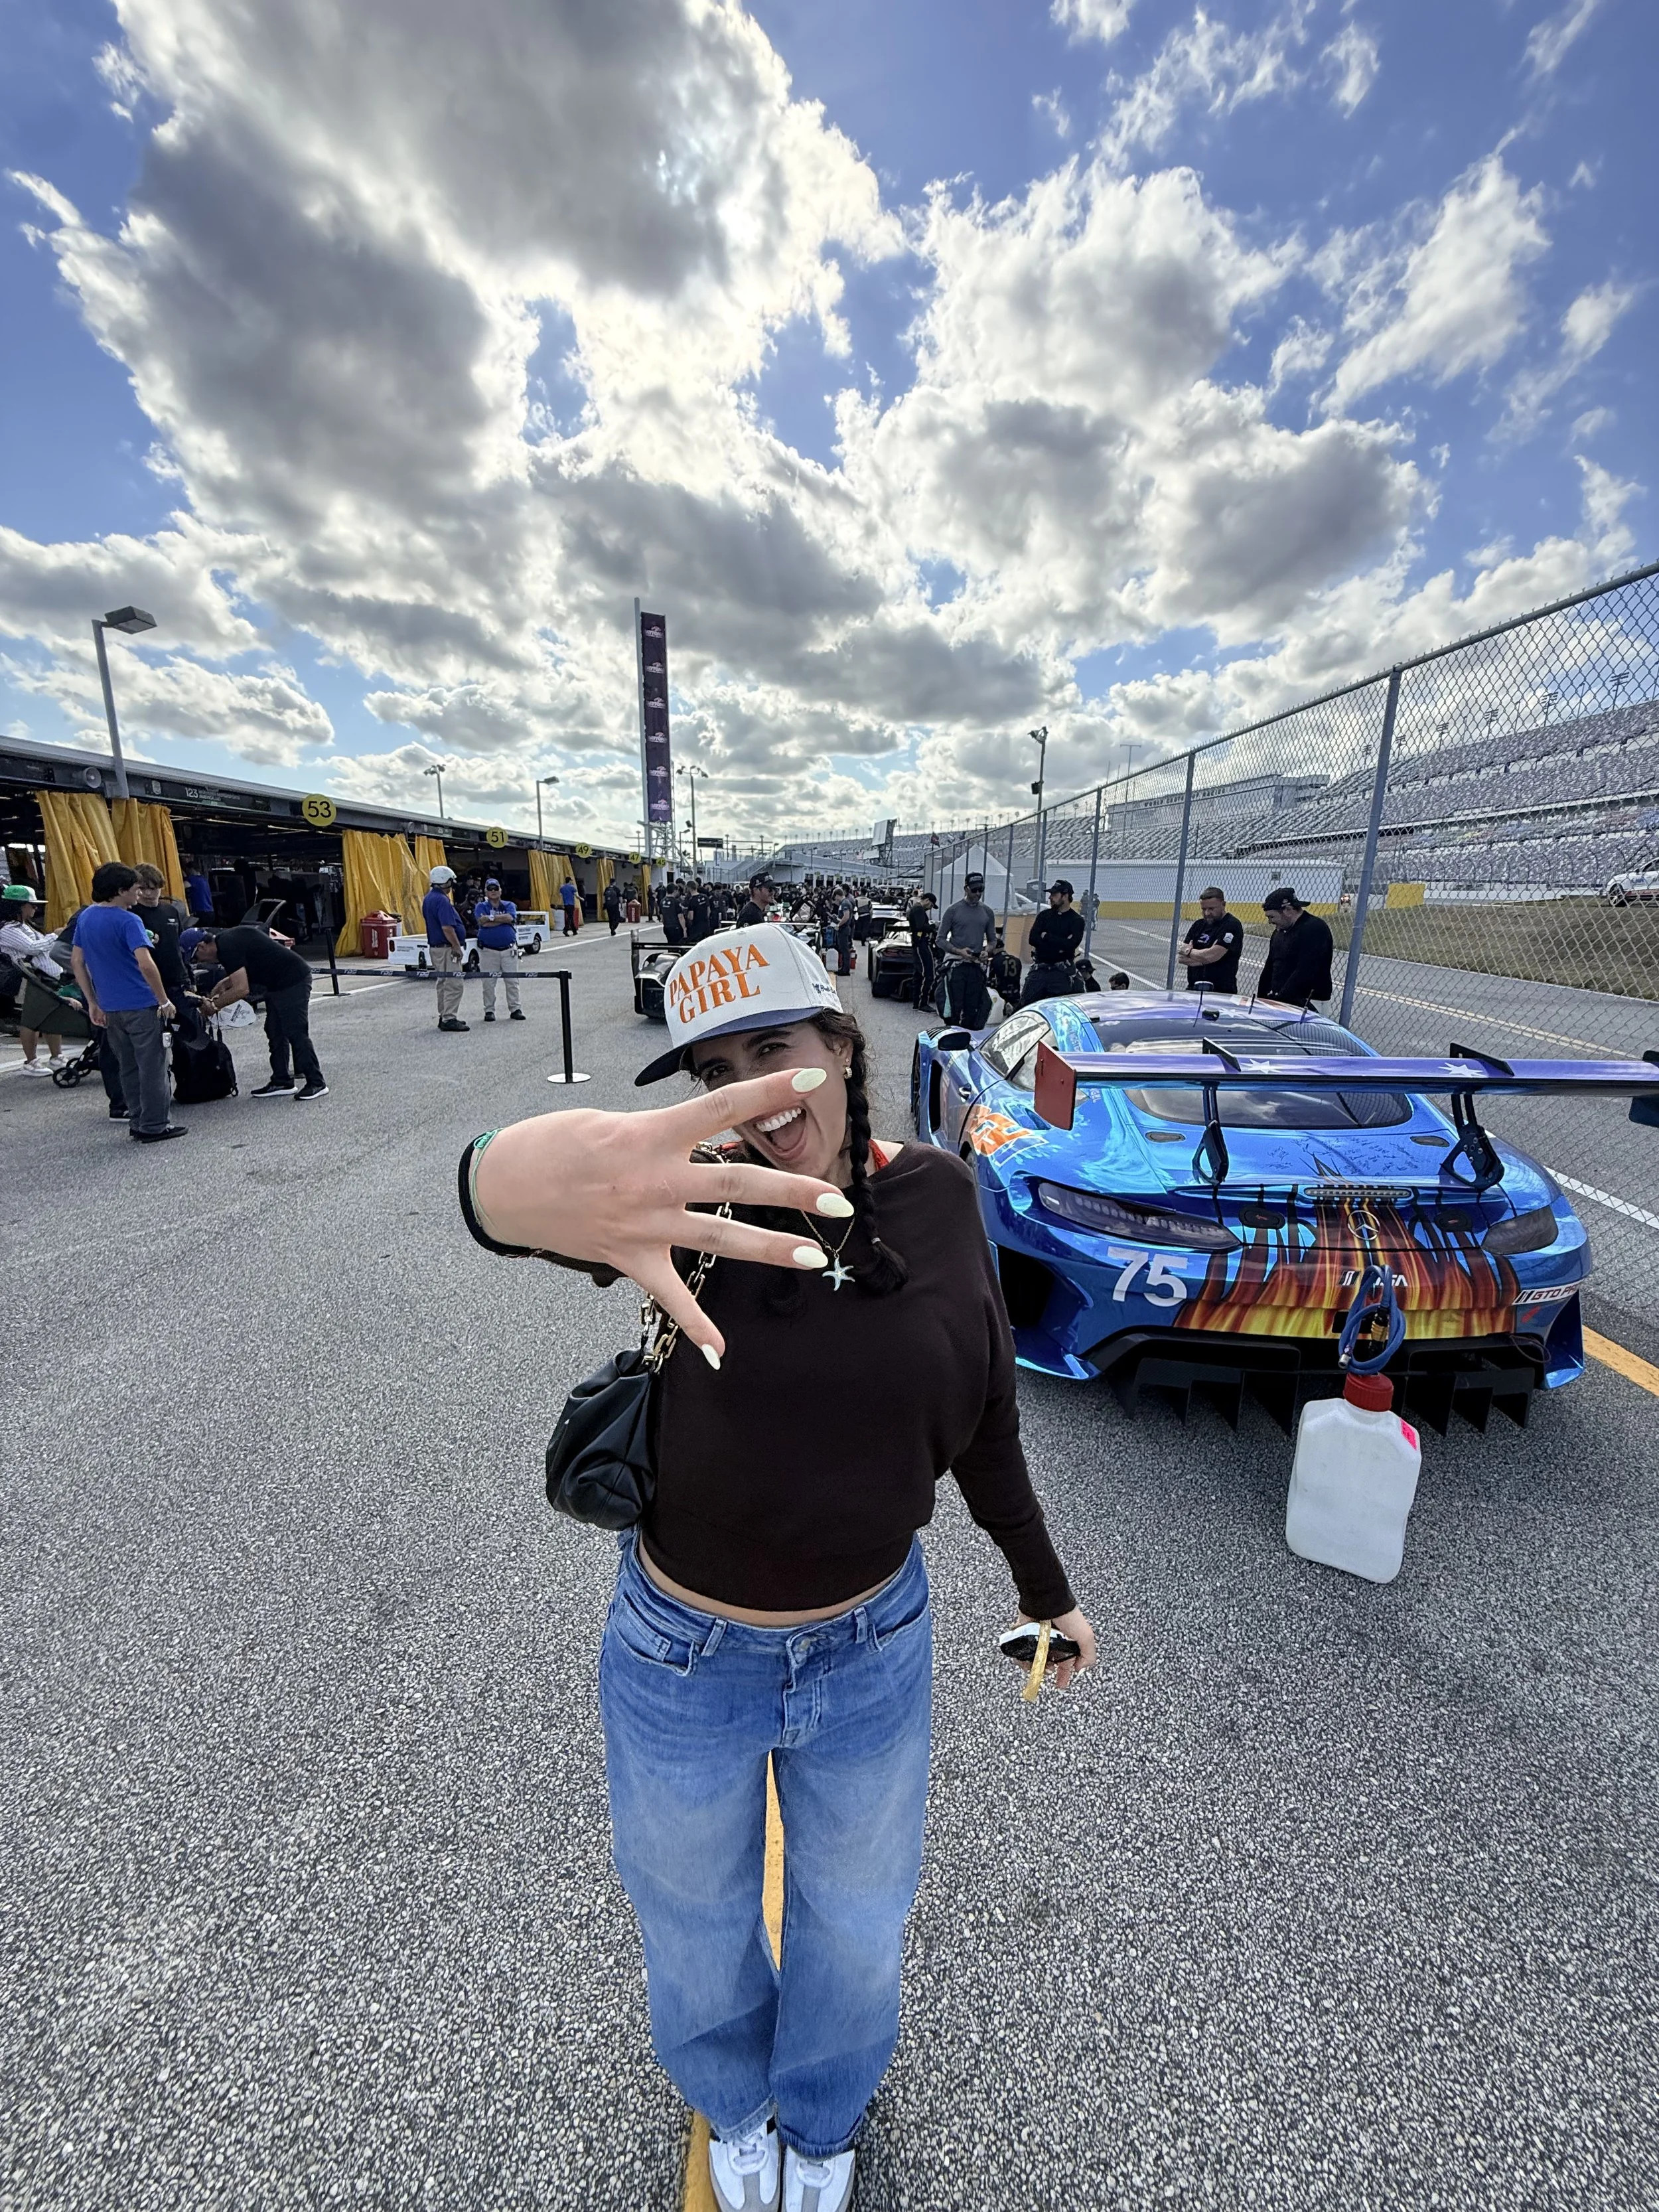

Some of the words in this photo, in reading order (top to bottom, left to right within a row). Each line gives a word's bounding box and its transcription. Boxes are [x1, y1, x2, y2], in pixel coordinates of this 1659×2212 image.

[185, 787, 198, 798] 123
[308, 800, 332, 818] 53
[491, 831, 504, 843] 51
[578, 846, 589, 855] 49
[669, 944, 770, 1008] PAPAYA
[1003, 959, 1017, 976] 13
[679, 972, 760, 1023] GIRL
[1108, 1246, 1188, 1307] 75
[1531, 1288, 1561, 1301] GTD
